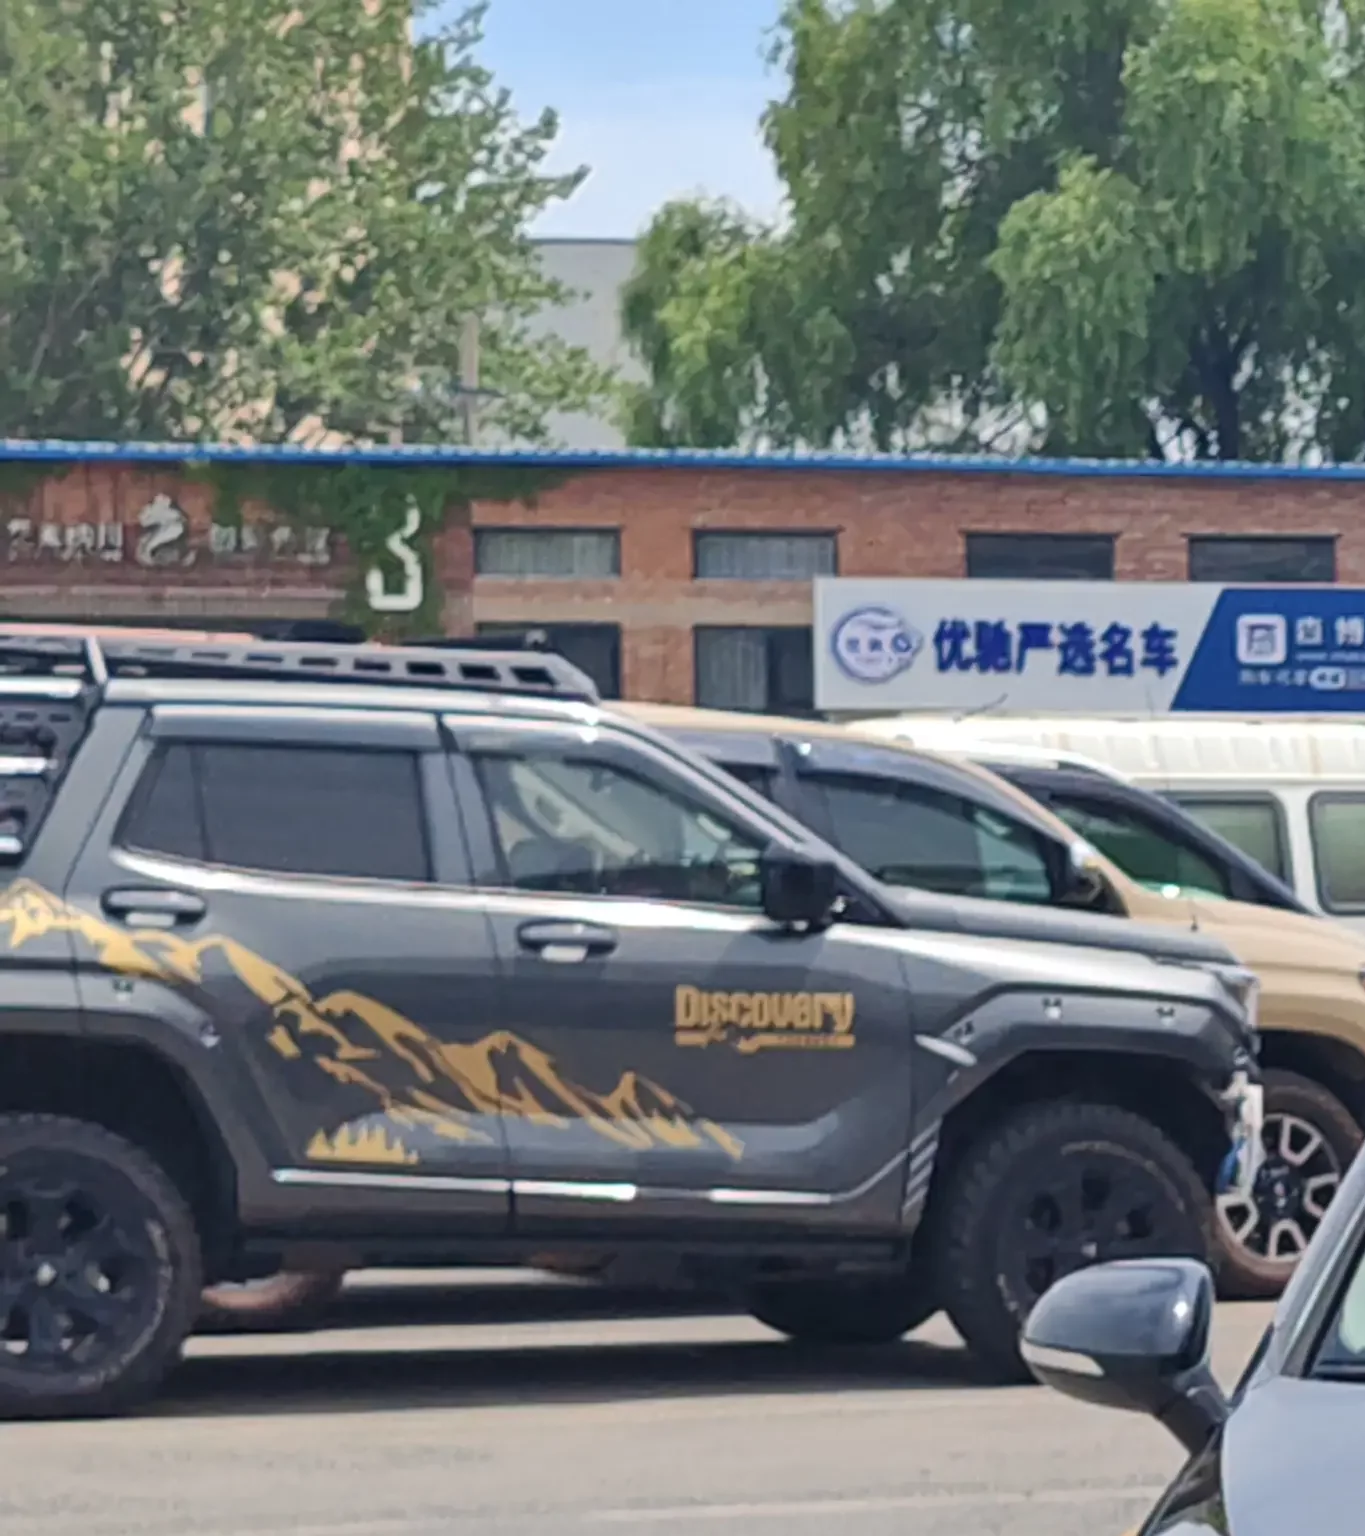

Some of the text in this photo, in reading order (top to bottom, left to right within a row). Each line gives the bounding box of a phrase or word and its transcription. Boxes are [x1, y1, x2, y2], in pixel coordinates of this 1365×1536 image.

[934, 617, 1178, 677] 优驰严选名车
